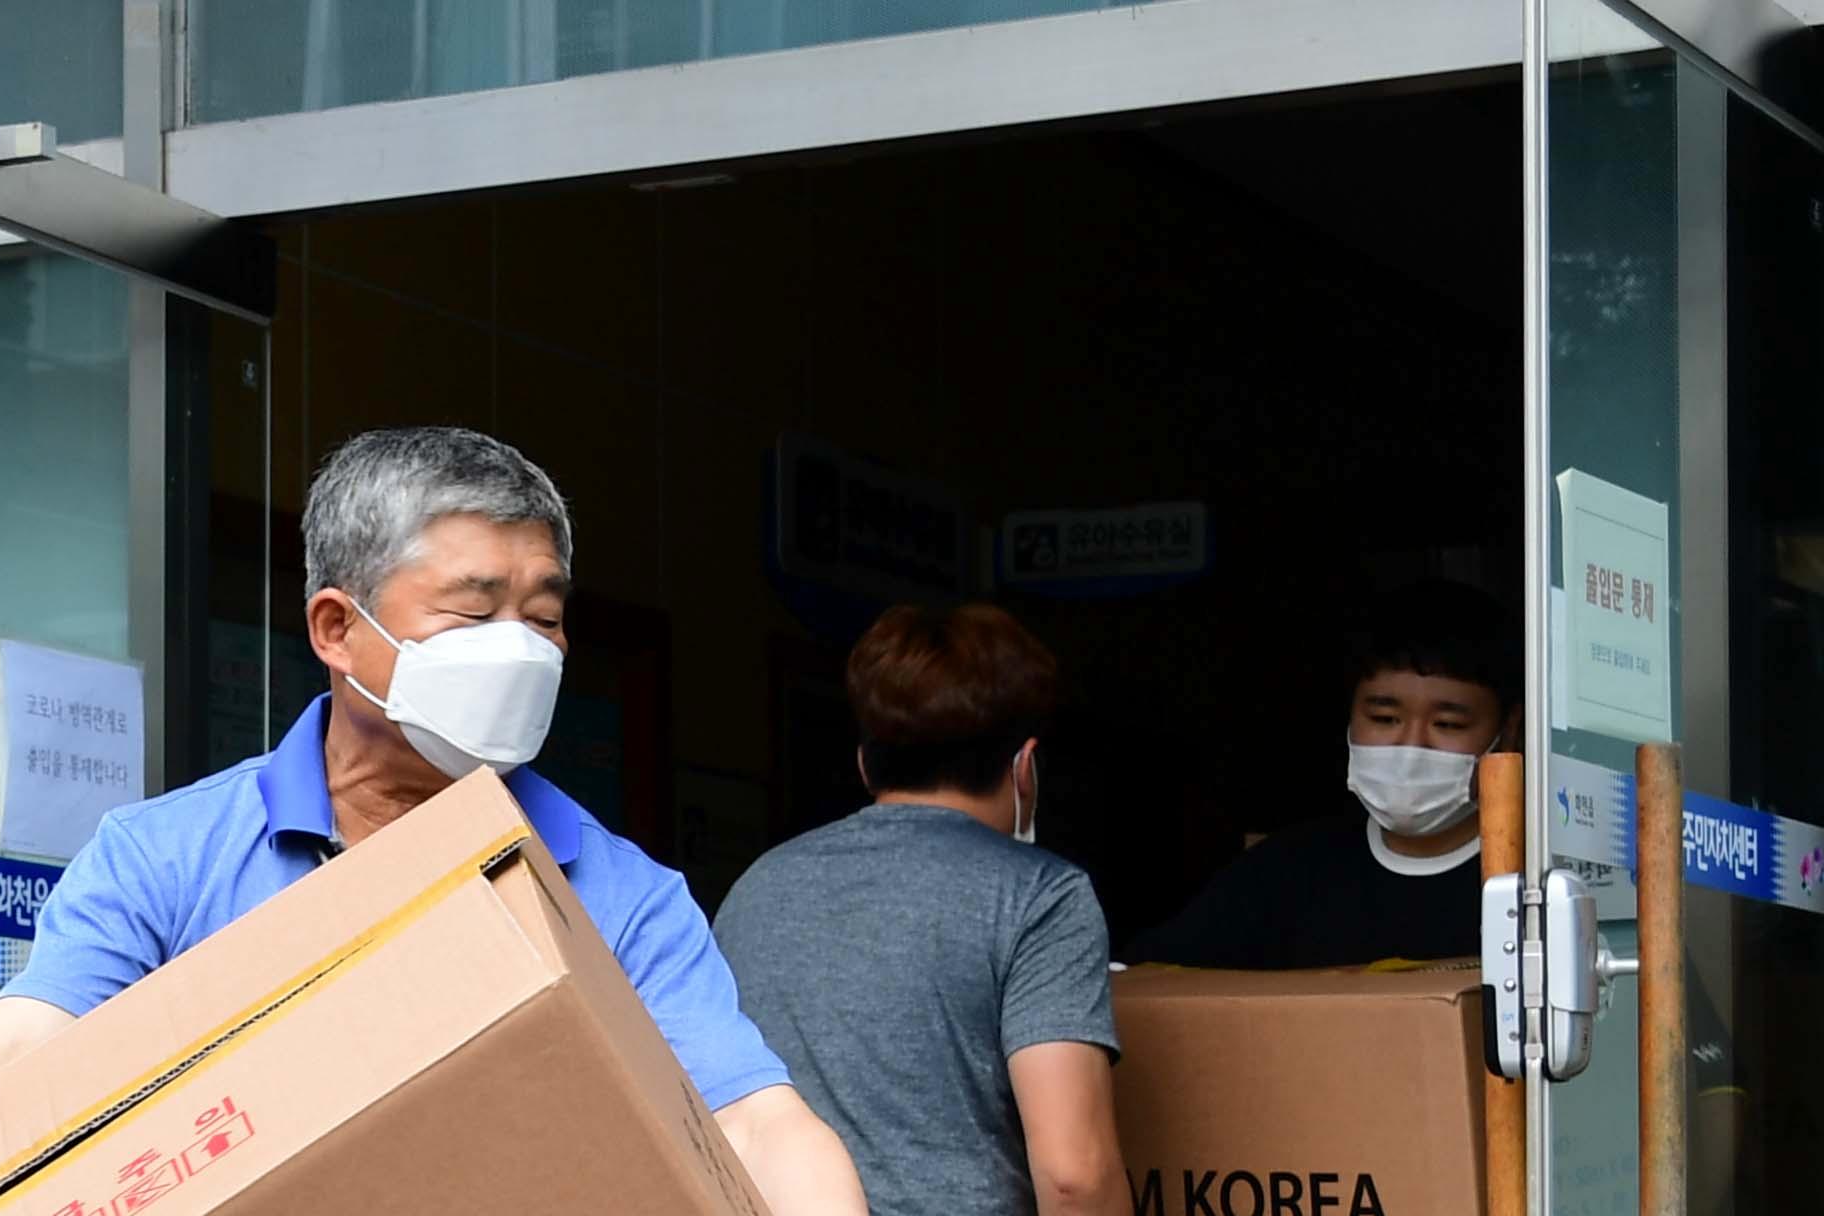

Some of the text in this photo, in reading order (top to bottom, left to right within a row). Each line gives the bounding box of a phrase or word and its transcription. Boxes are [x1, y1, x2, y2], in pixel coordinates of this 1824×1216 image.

[1586, 563, 1654, 624] 출입문 통제
[25, 694, 63, 724] 코로나
